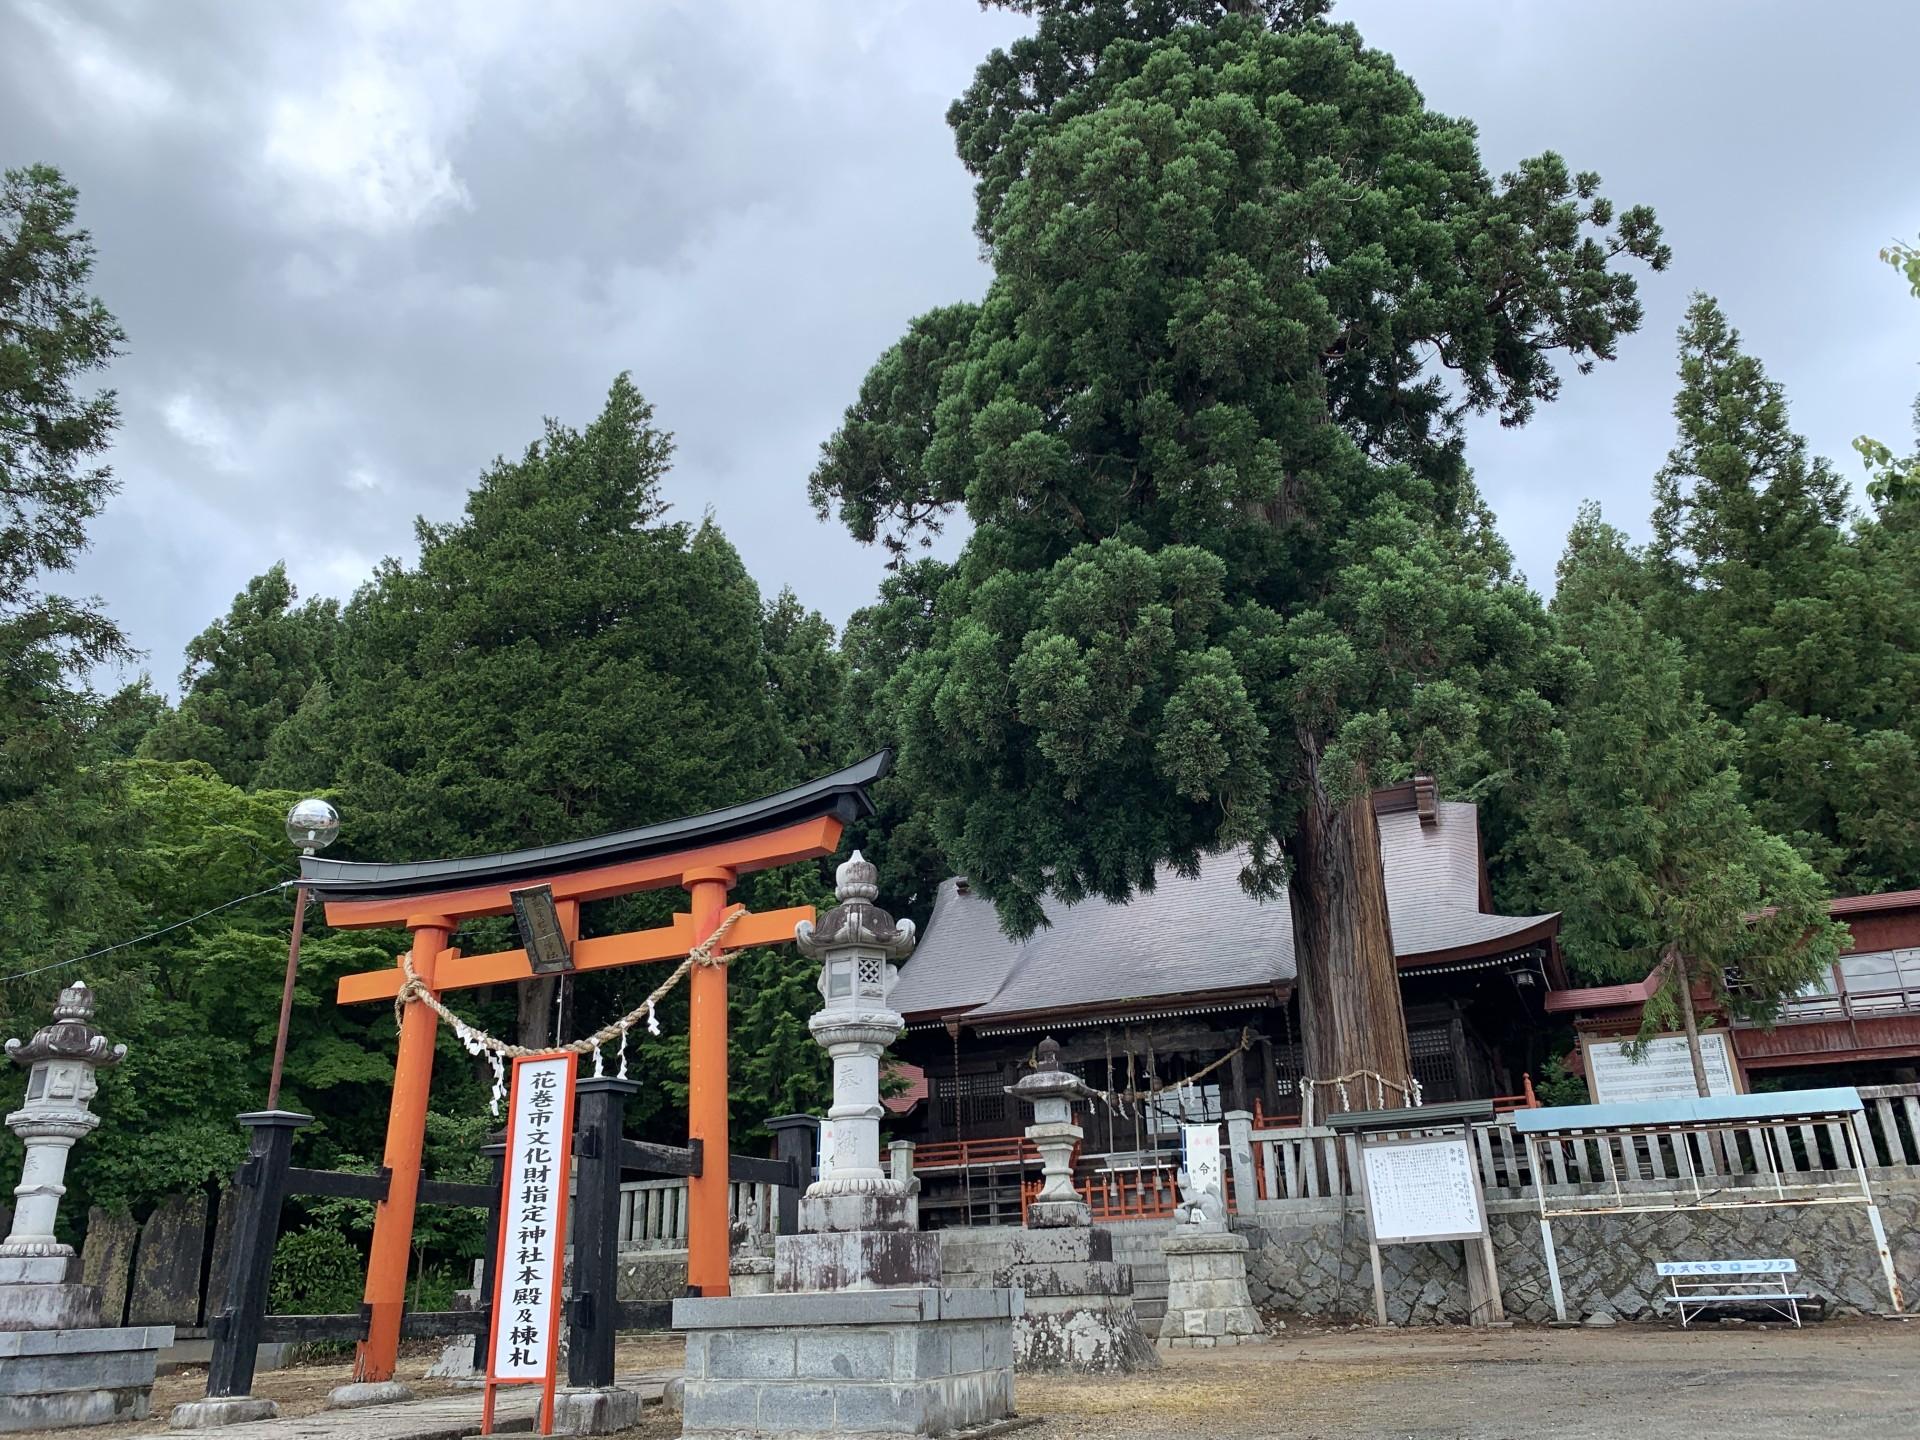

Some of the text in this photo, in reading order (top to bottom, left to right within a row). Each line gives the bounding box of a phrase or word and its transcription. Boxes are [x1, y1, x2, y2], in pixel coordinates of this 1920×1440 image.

[507, 1071, 557, 1367] 花巻市文化財指定神社本殿及棟札
[1663, 1260, 1791, 1274] カメヤマ ローソク
